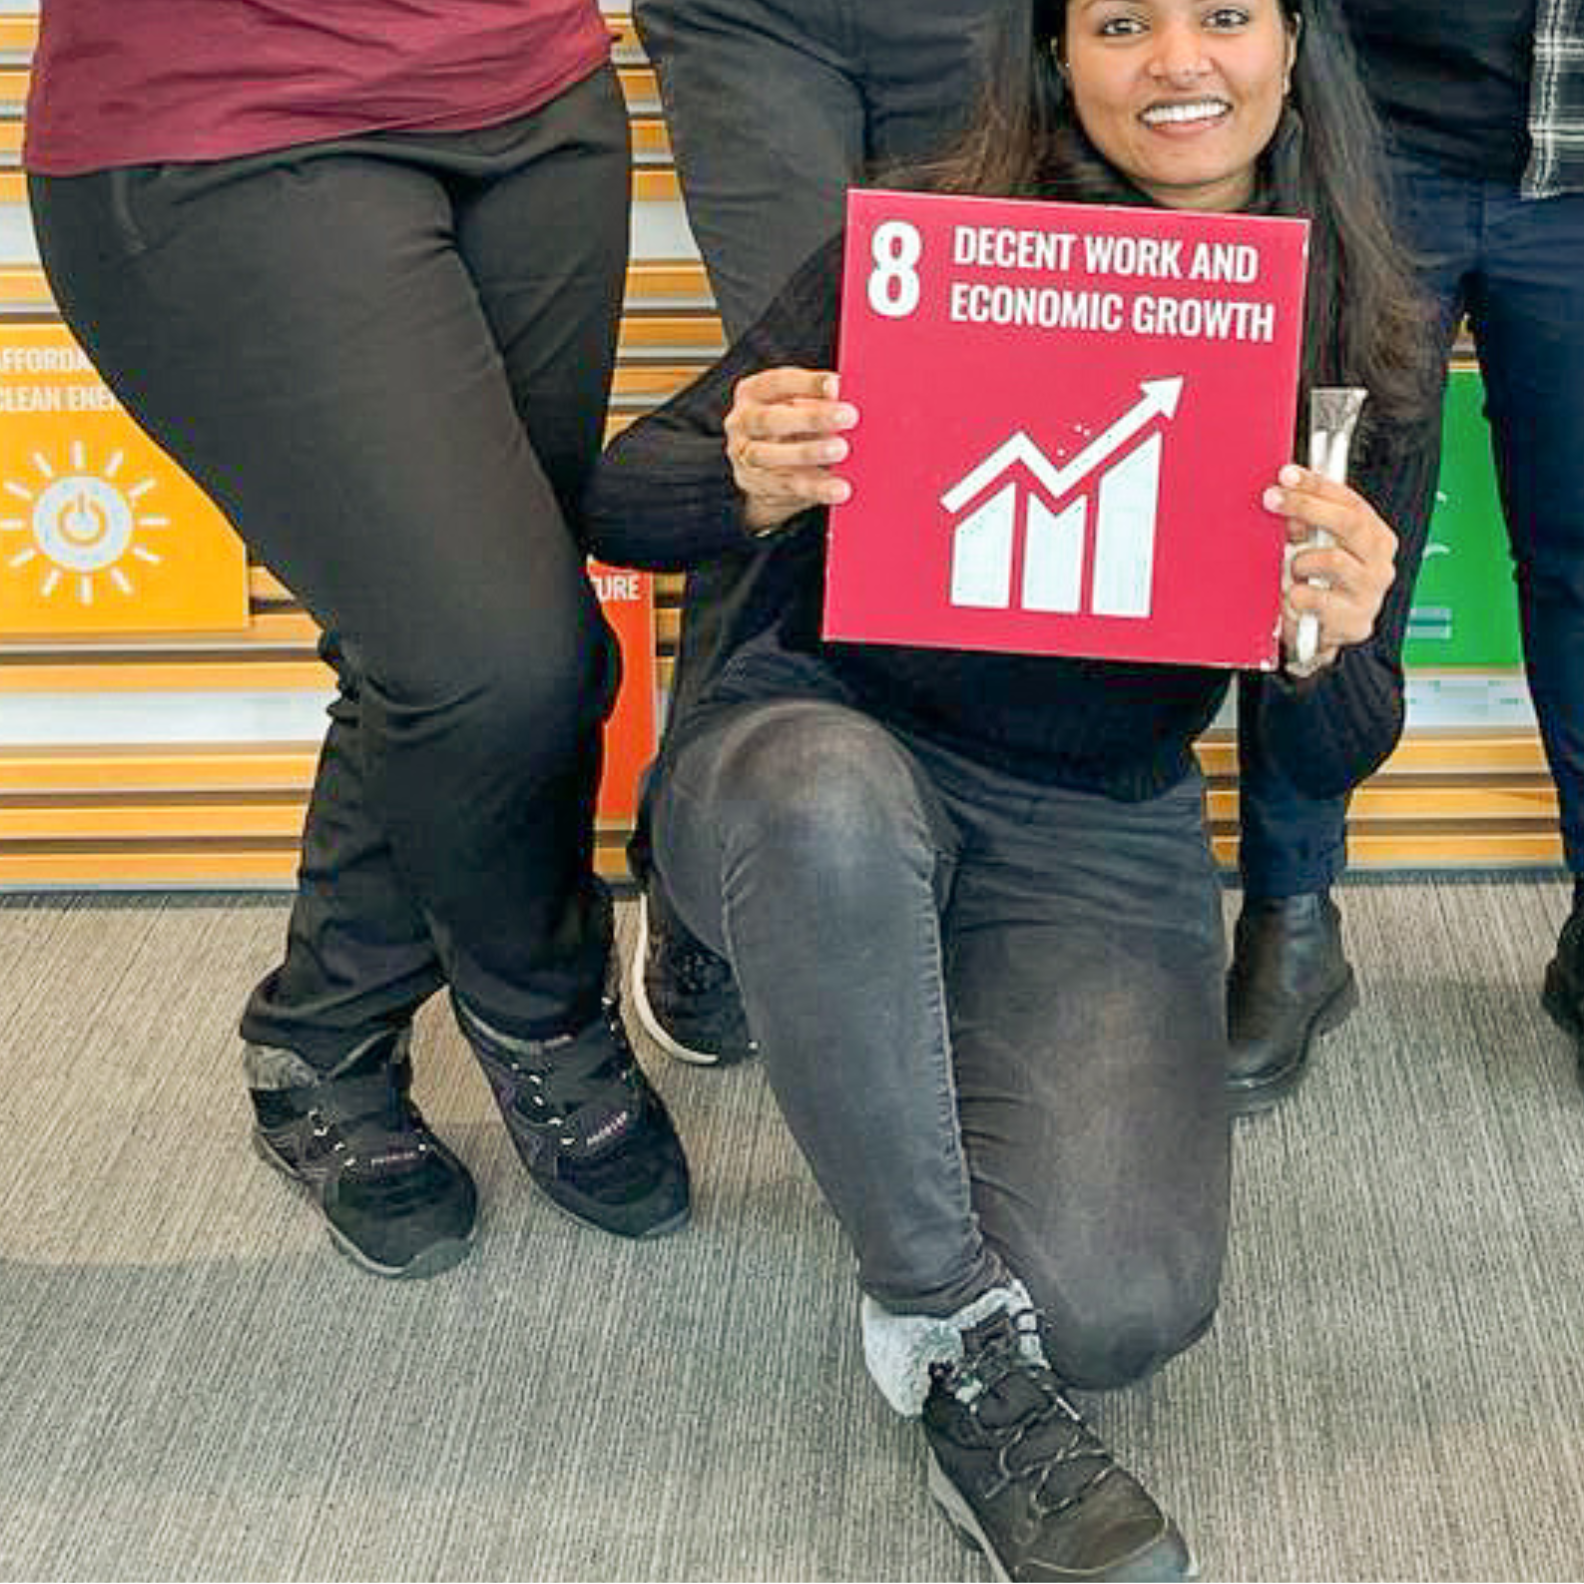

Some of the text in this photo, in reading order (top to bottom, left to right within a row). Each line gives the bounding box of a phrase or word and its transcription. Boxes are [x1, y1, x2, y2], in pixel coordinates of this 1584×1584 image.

[868, 221, 921, 316] 8
[954, 226, 1258, 282] DECENT WORK AND
[951, 283, 1274, 341] ECONOMIC GROWTH
[0, 347, 97, 370] FFORDA
